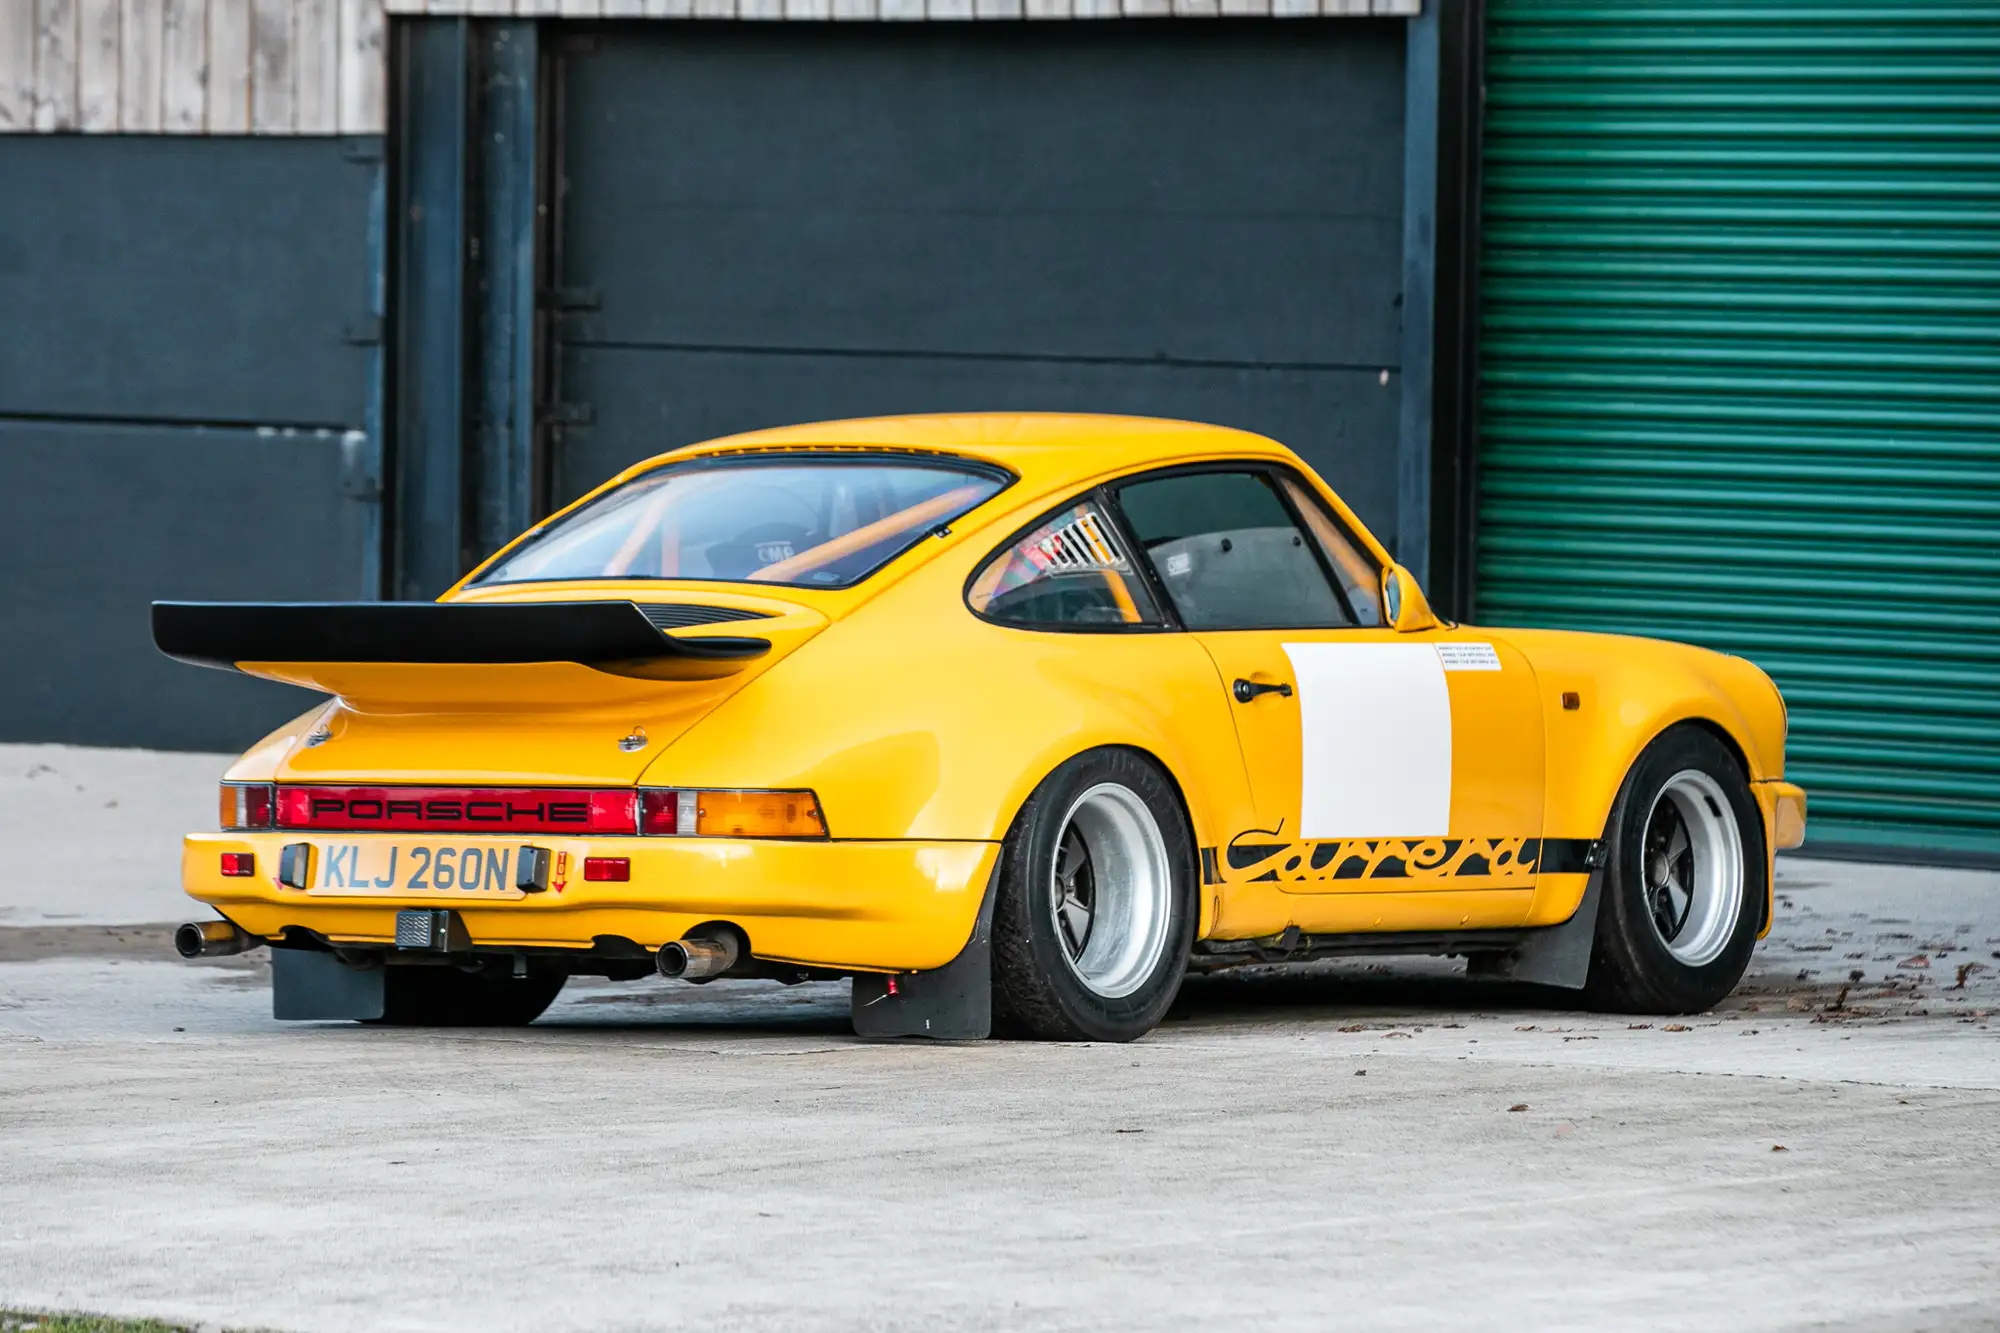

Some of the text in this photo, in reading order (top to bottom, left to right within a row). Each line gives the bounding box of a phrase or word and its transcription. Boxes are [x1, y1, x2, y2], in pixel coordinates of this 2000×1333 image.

[312, 801, 588, 822] PORSCHE
[324, 845, 509, 891] KLJ 260N
[1226, 817, 1537, 884] Carrera
